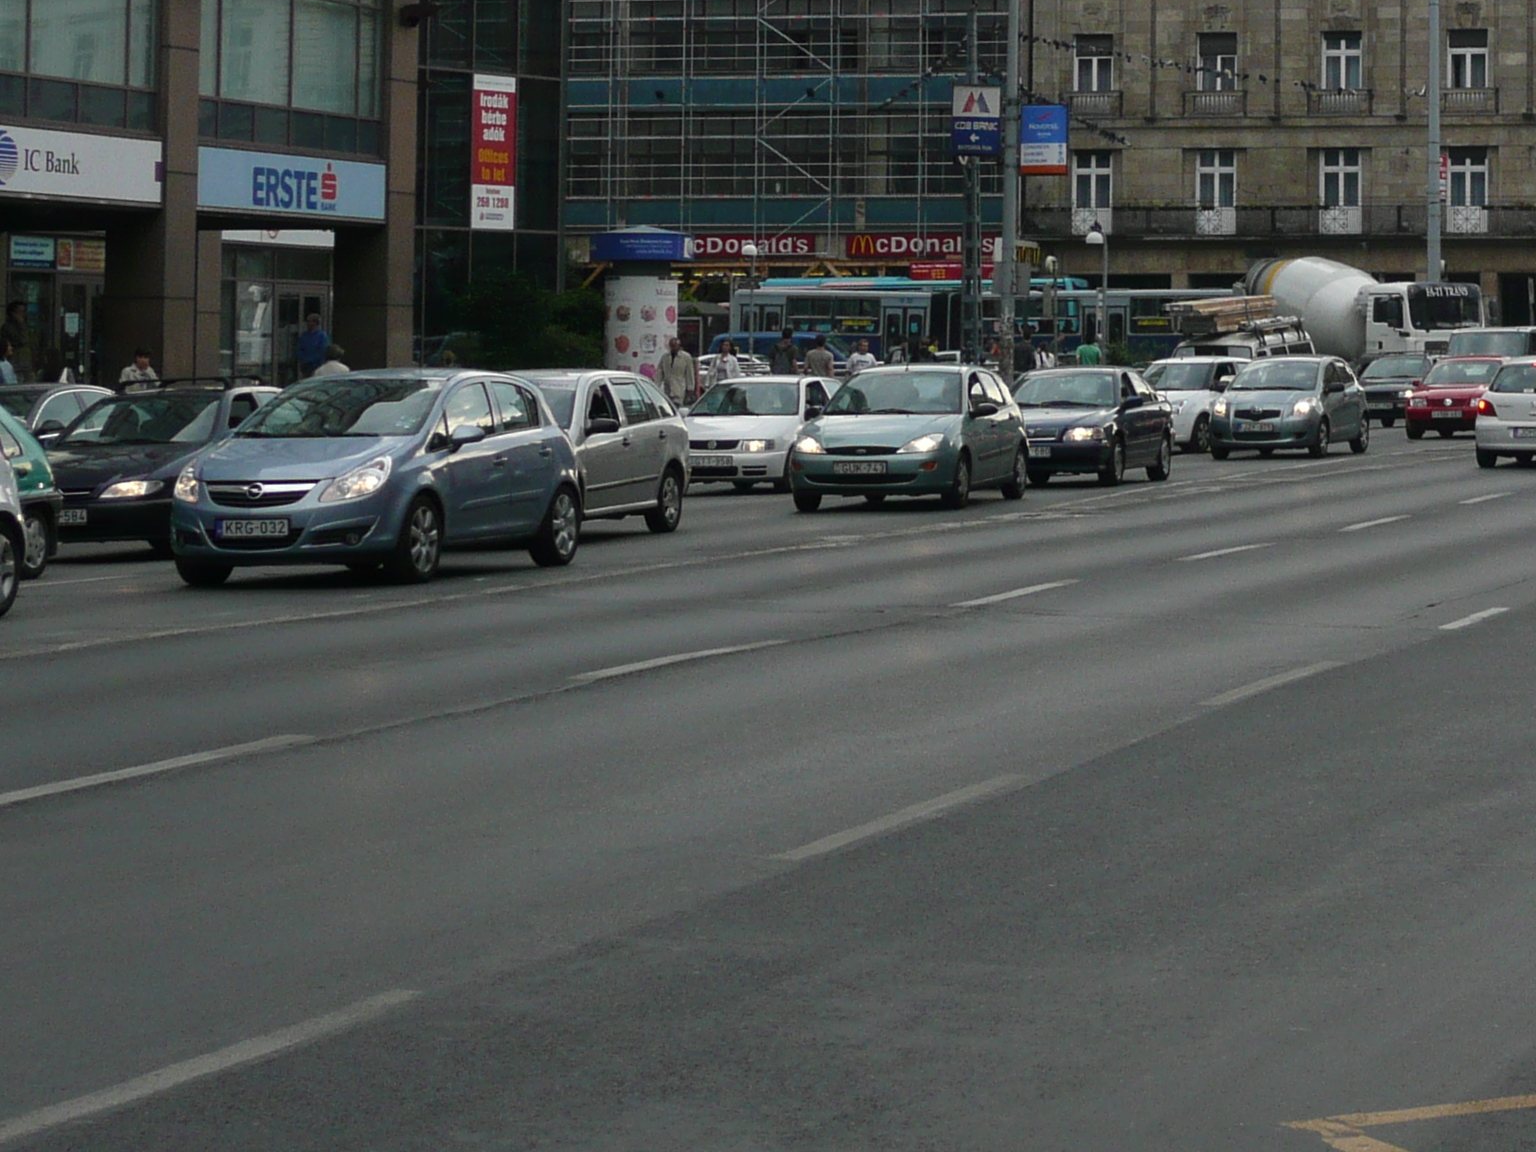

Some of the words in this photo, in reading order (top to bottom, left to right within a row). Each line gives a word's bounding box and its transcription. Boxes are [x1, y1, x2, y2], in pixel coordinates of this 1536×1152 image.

[480, 92, 509, 109] Irodák
[481, 109, 507, 125] bérbe
[24, 149, 41, 172] IC
[45, 151, 80, 175] Bank
[252, 166, 319, 211] ERSTE
[224, 520, 287, 535] KRG-032
